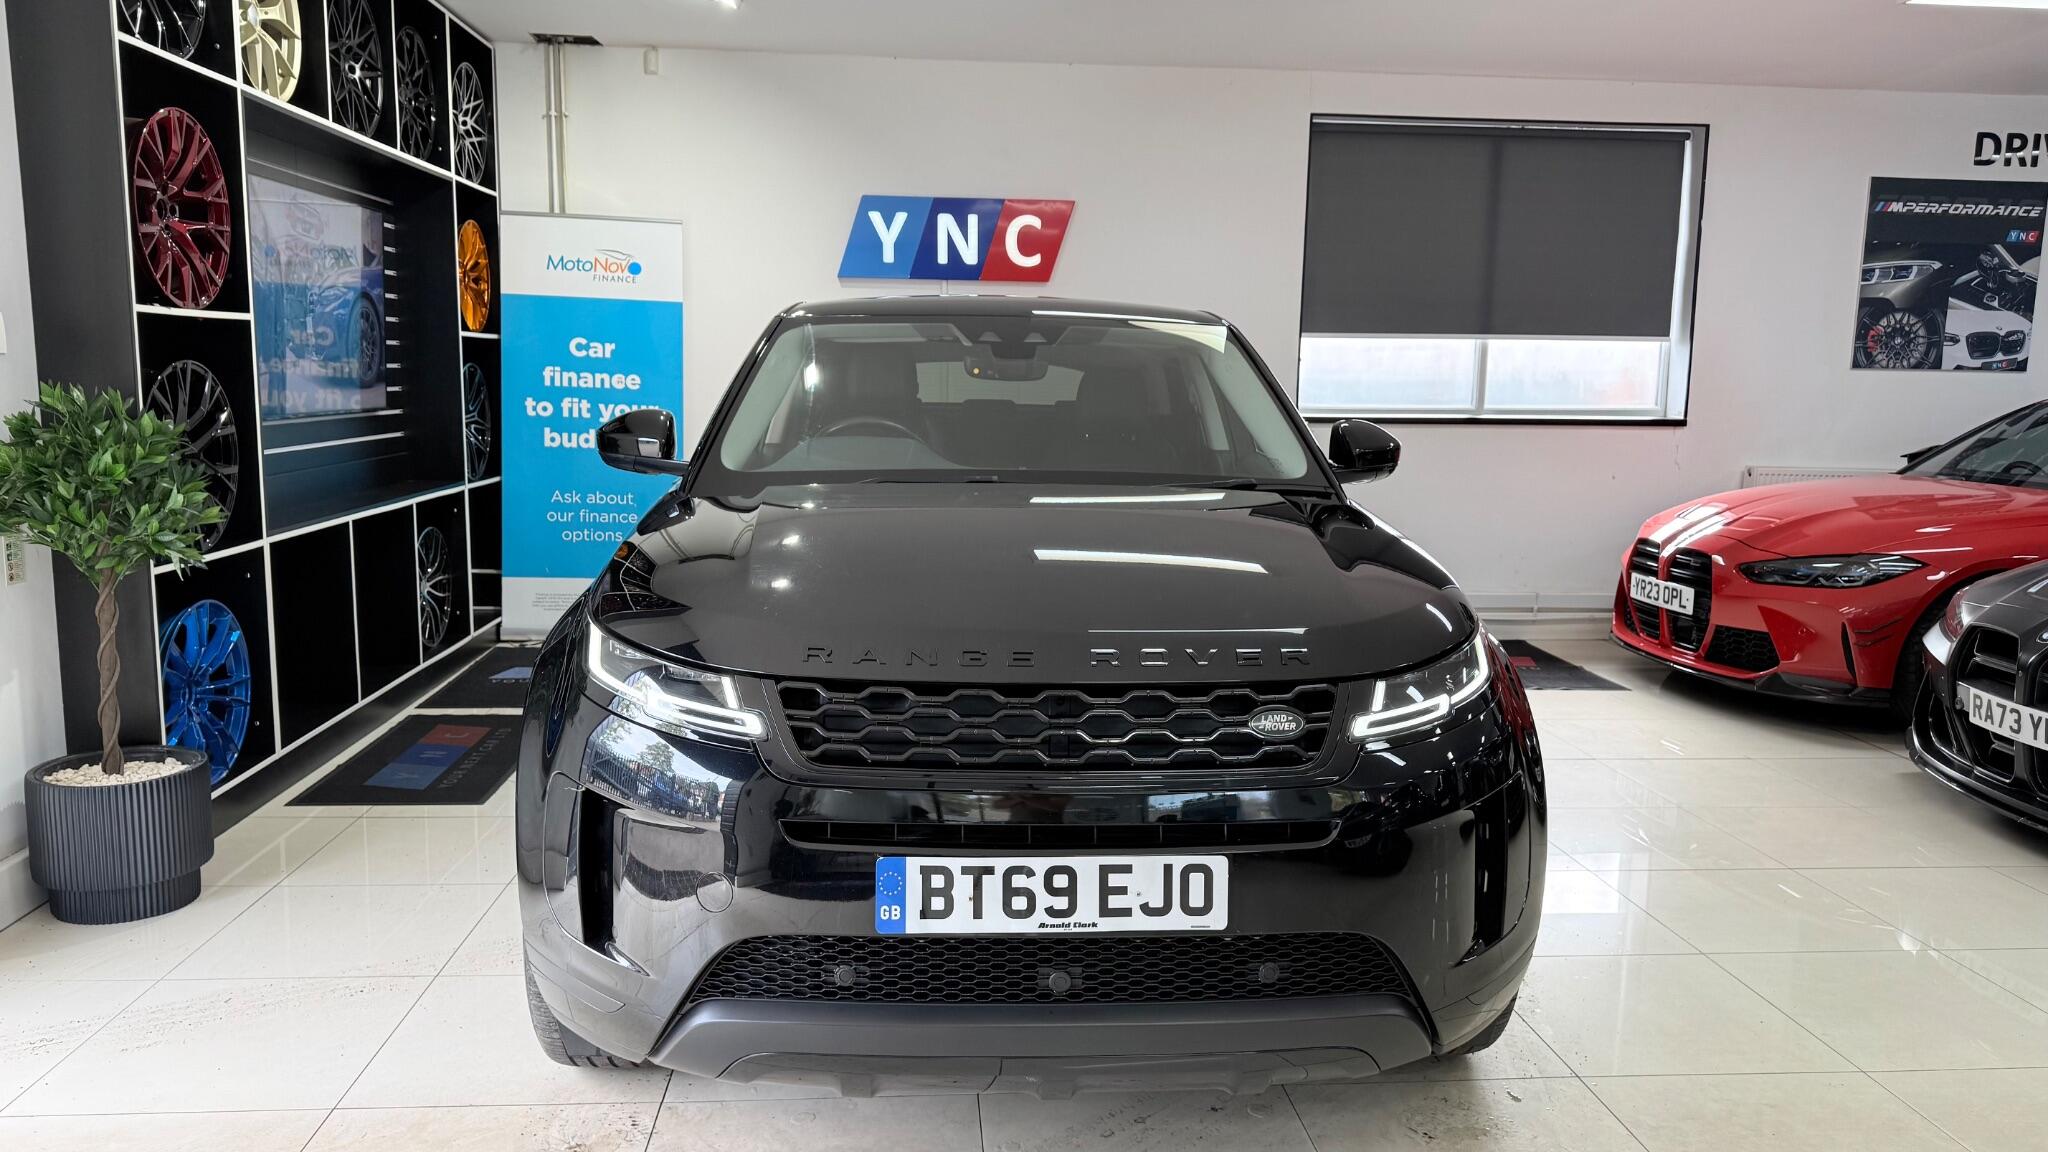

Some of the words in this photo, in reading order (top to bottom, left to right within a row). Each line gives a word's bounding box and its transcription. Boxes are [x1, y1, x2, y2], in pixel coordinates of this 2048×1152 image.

[1974, 131, 2048, 168] DRI
[867, 211, 1042, 267] YNC
[2010, 232, 2036, 241] YNC
[593, 274, 637, 284] FINANCE
[569, 337, 615, 358] Car
[543, 366, 641, 389] finance
[525, 396, 554, 418] to
[561, 397, 591, 419] fit
[598, 402, 660, 423] yo
[543, 427, 596, 449] bud
[551, 489, 582, 504] Ask
[546, 511, 575, 523] our
[579, 508, 638, 524] finance
[561, 528, 624, 543] options
[1634, 576, 1661, 602] YR23
[1662, 585, 1687, 609] OPL
[802, 647, 1036, 668] RANGE
[1090, 648, 1311, 668] ROVER
[1261, 714, 1287, 724] LAND
[1265, 722, 1297, 731] ROVER
[1972, 692, 2022, 735] RA73
[2028, 712, 2048, 745] Y
[919, 865, 1078, 920] BT69
[1098, 863, 1214, 918] EJO
[880, 904, 901, 921] GB
